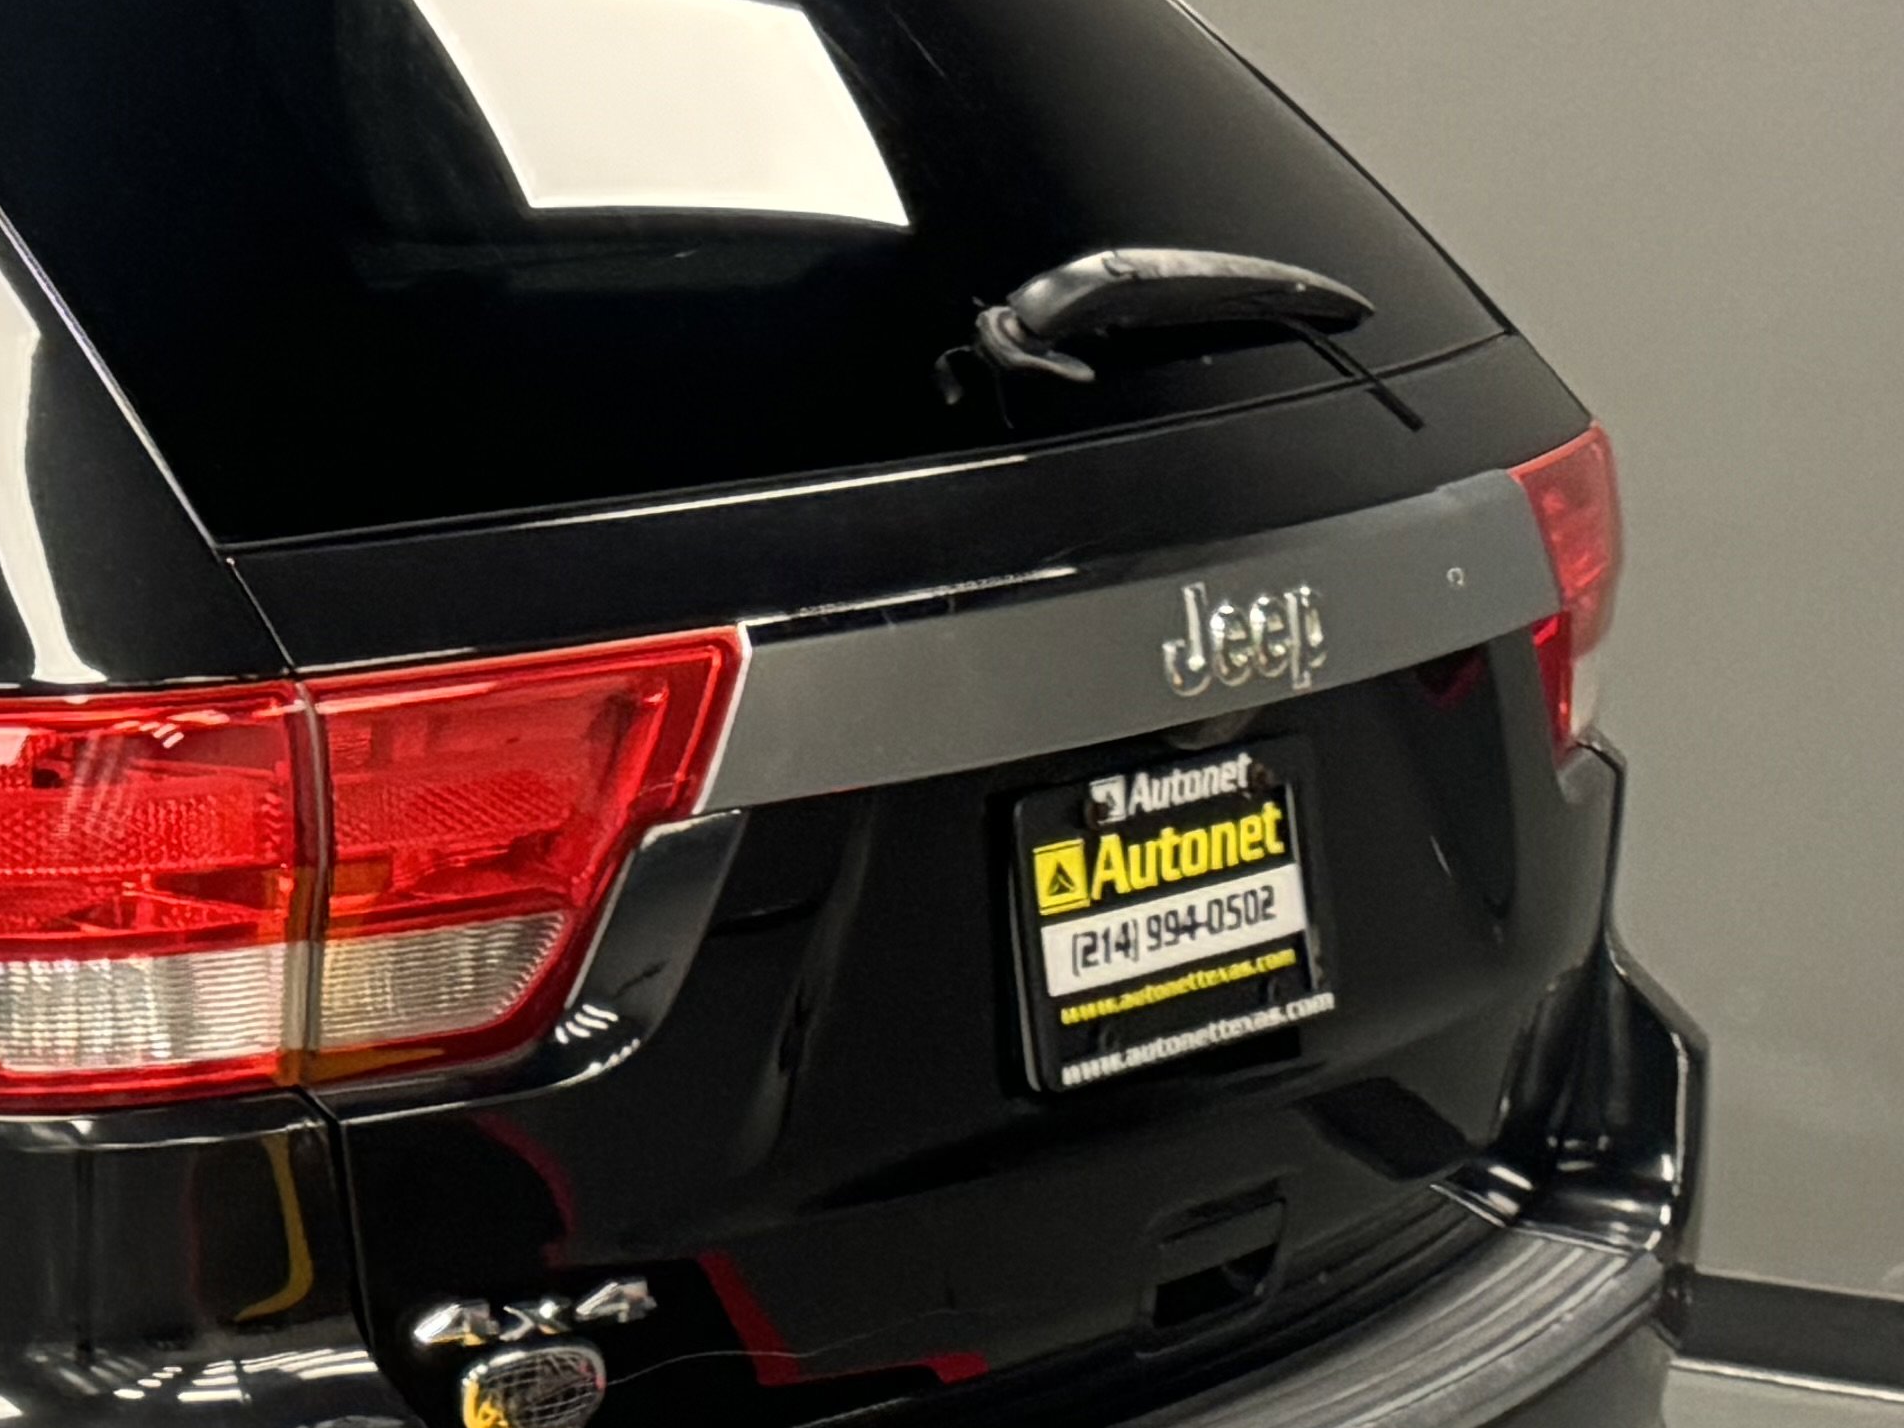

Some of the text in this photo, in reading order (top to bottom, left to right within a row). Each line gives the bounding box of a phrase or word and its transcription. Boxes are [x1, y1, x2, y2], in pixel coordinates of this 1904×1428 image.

[1162, 582, 1327, 698] Jeep
[1127, 752, 1252, 816] Autonet
[1092, 803, 1285, 900] Autonet
[1072, 885, 1276, 977] (214) 994-0502
[1061, 948, 1296, 1025] www.autonettexas.com
[1062, 992, 1335, 1085] www.autonettexas.com
